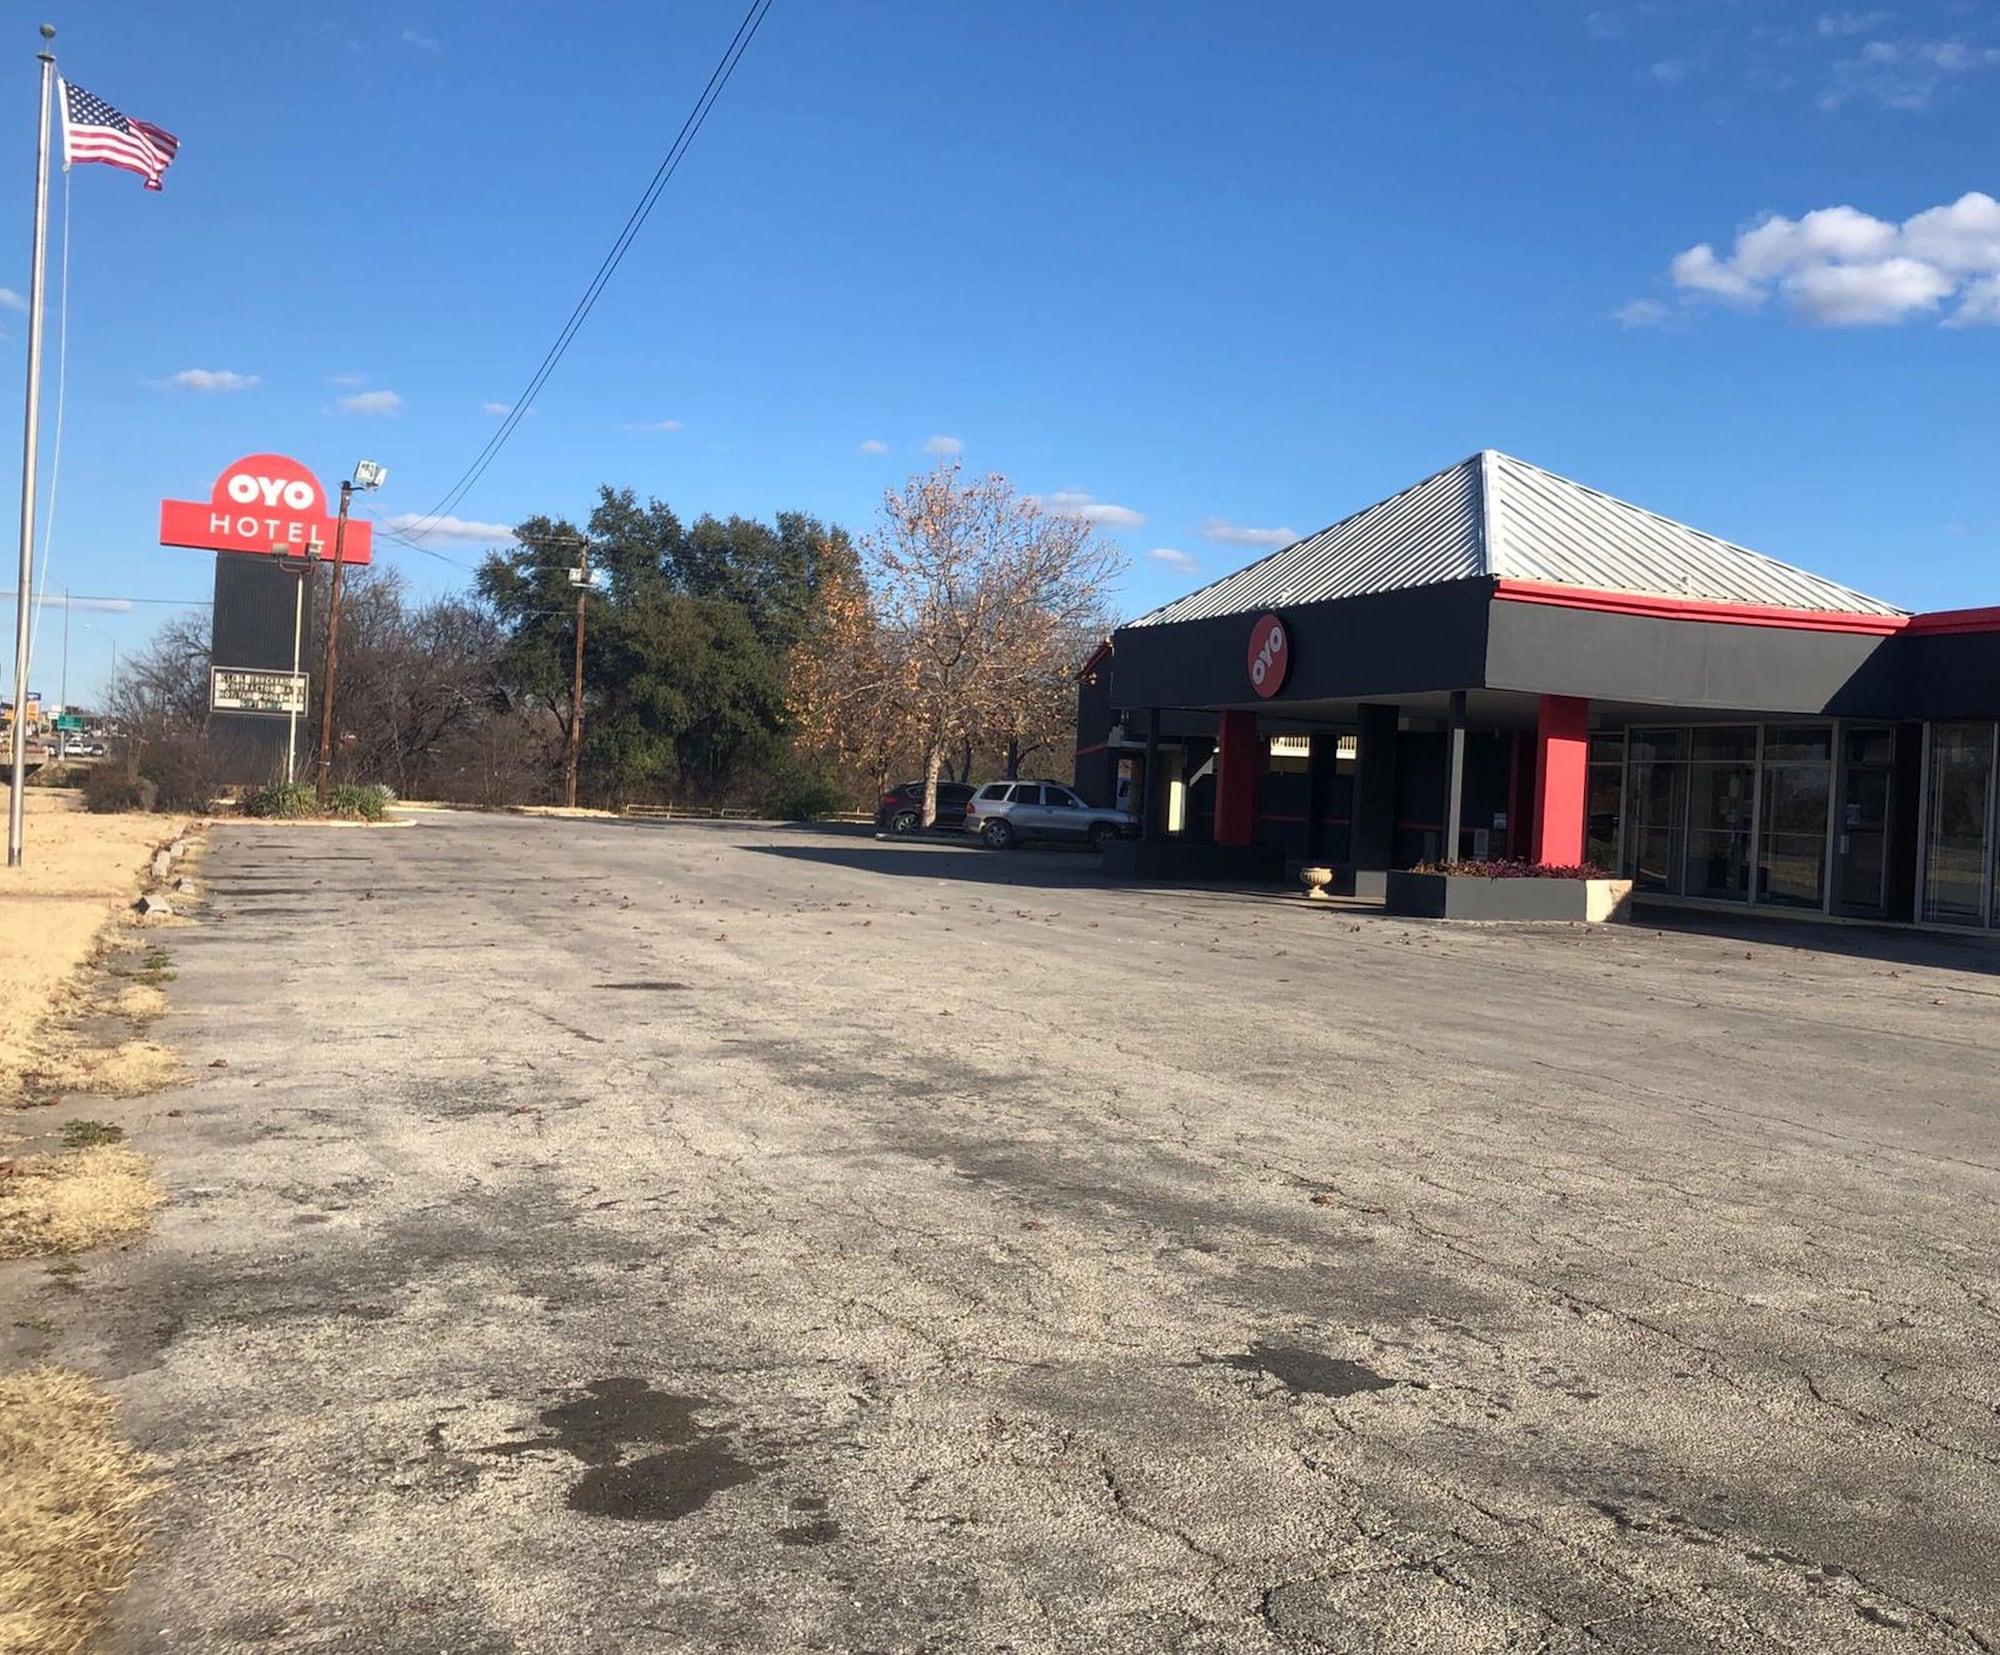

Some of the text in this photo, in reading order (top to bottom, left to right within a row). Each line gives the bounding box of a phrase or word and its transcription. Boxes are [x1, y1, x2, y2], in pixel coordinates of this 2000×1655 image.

[228, 474, 314, 510] OYO
[209, 512, 325, 545] HOTEL
[1252, 627, 1282, 685] OYO
